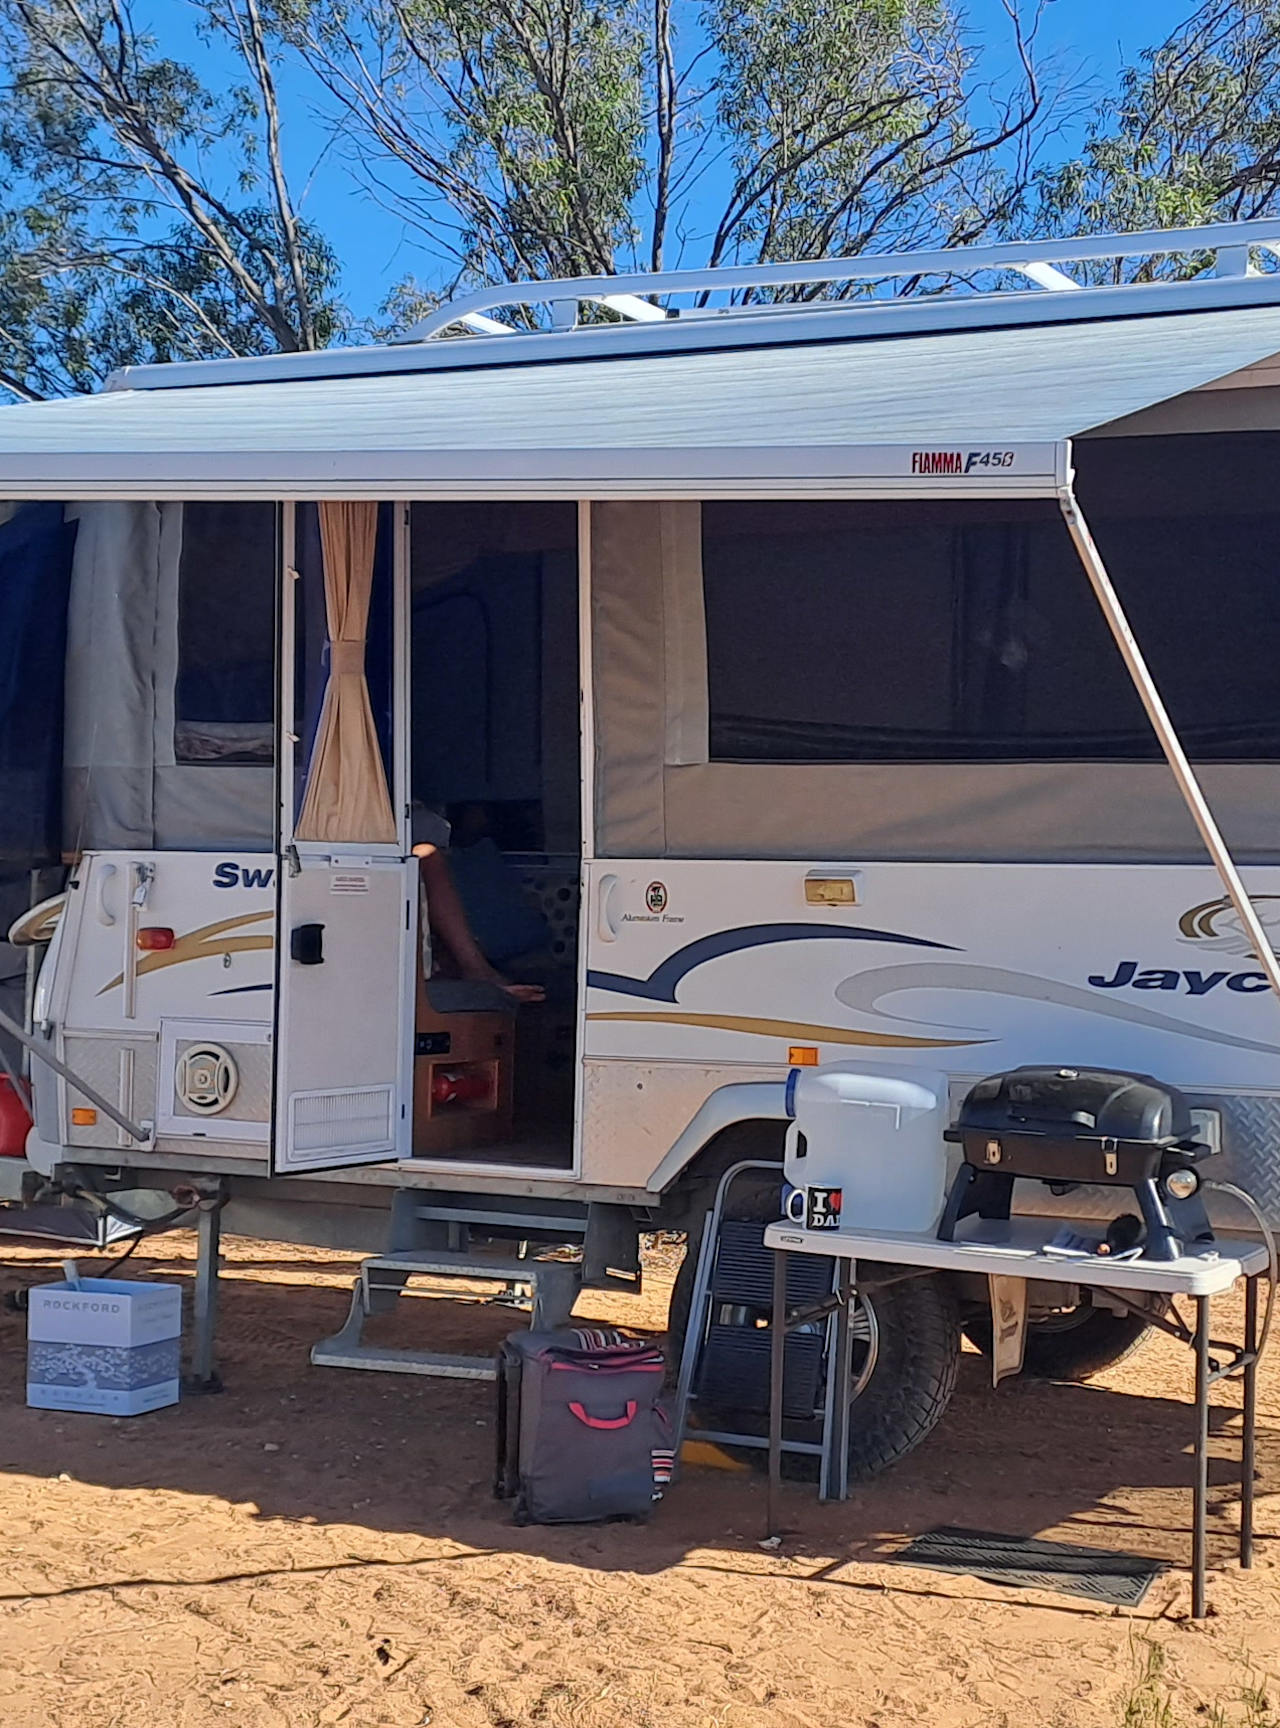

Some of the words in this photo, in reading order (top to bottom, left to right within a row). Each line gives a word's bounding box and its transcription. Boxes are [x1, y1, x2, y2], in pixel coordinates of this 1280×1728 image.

[912, 452, 962, 474] FIAMMA
[212, 862, 275, 889] Sw
[813, 1191, 828, 1212] I
[43, 1300, 120, 1314] ROCKFORD
